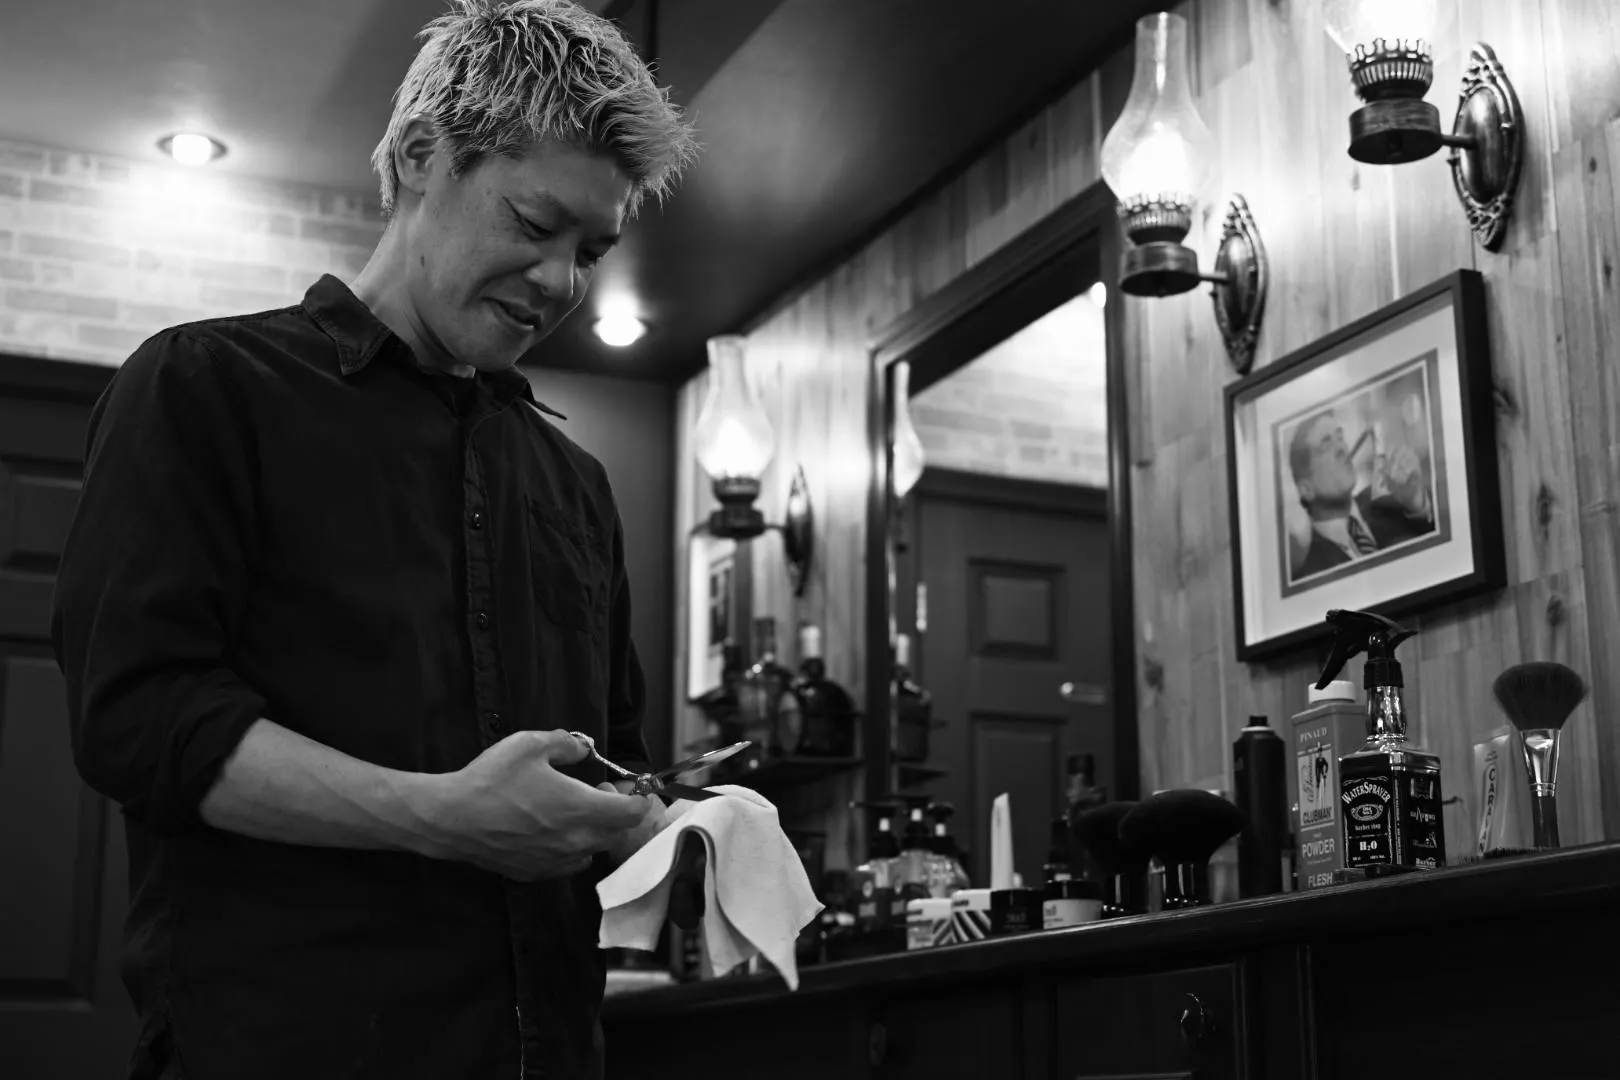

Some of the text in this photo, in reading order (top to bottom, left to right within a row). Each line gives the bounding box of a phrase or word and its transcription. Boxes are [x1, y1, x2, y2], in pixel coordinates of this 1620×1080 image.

[1300, 726, 1327, 743] PINAUD
[1303, 805, 1332, 824] CLUBMAN
[1302, 838, 1335, 858] POWDER
[1308, 872, 1333, 888] FLESH
